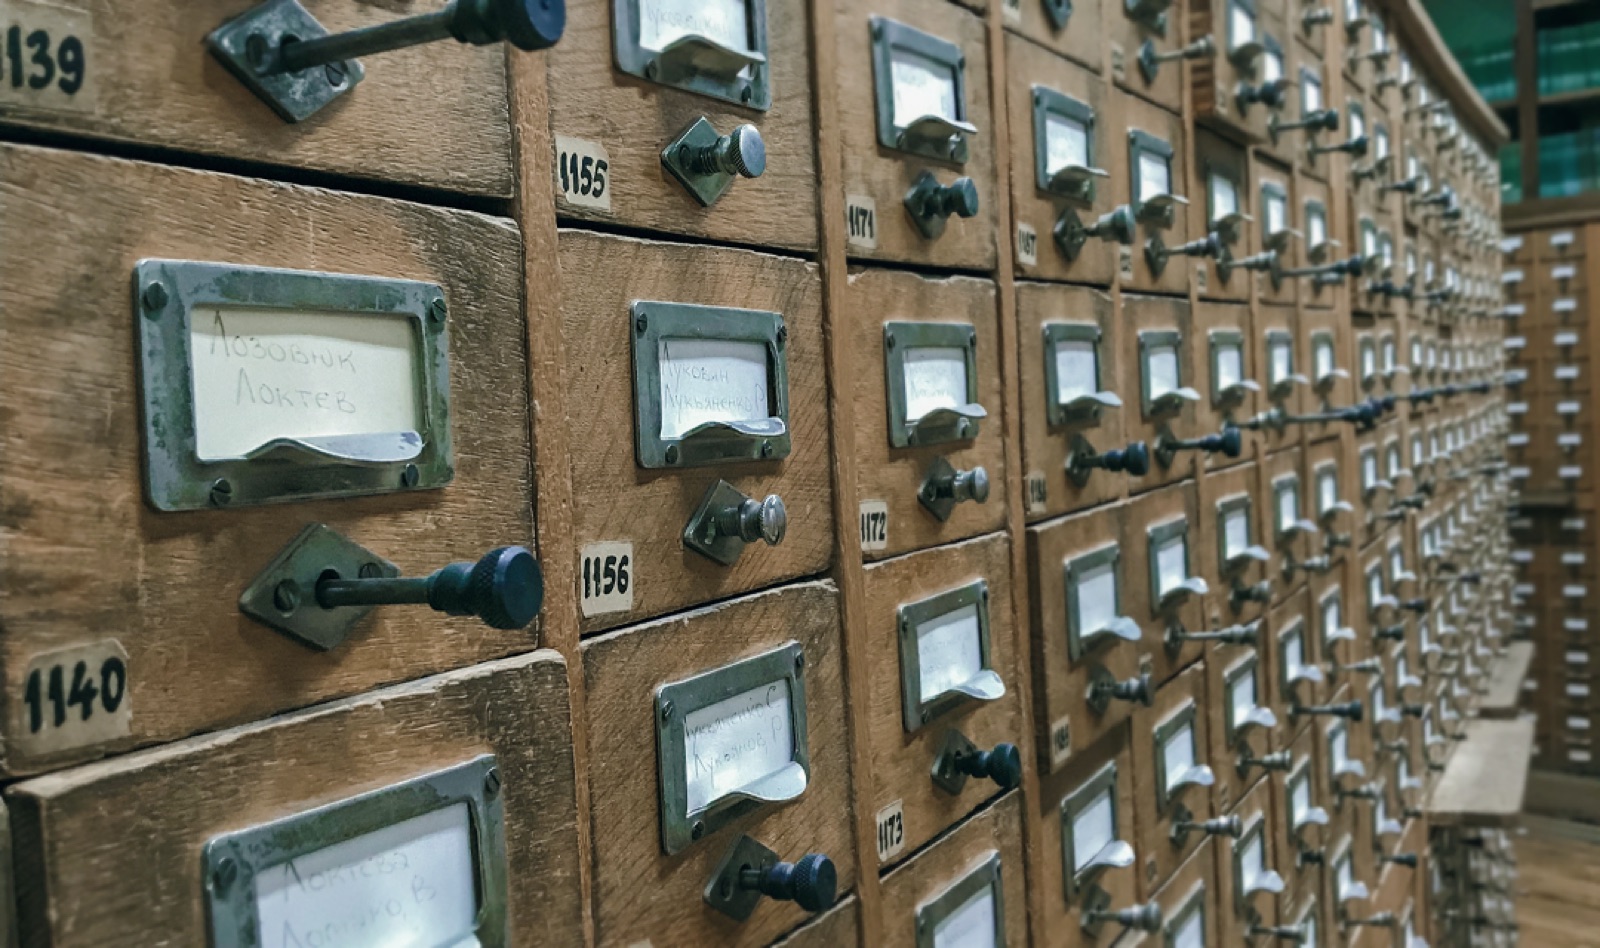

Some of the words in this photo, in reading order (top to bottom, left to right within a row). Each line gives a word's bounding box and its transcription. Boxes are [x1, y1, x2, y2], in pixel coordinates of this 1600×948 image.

[0, 24, 85, 96] 139
[560, 151, 607, 198] 1155
[849, 204, 874, 239] 1171
[236, 366, 357, 414] Локтев
[861, 511, 887, 543] 1172
[583, 554, 629, 600] 1156
[24, 655, 127, 735] 1140
[879, 811, 903, 854] 1173
